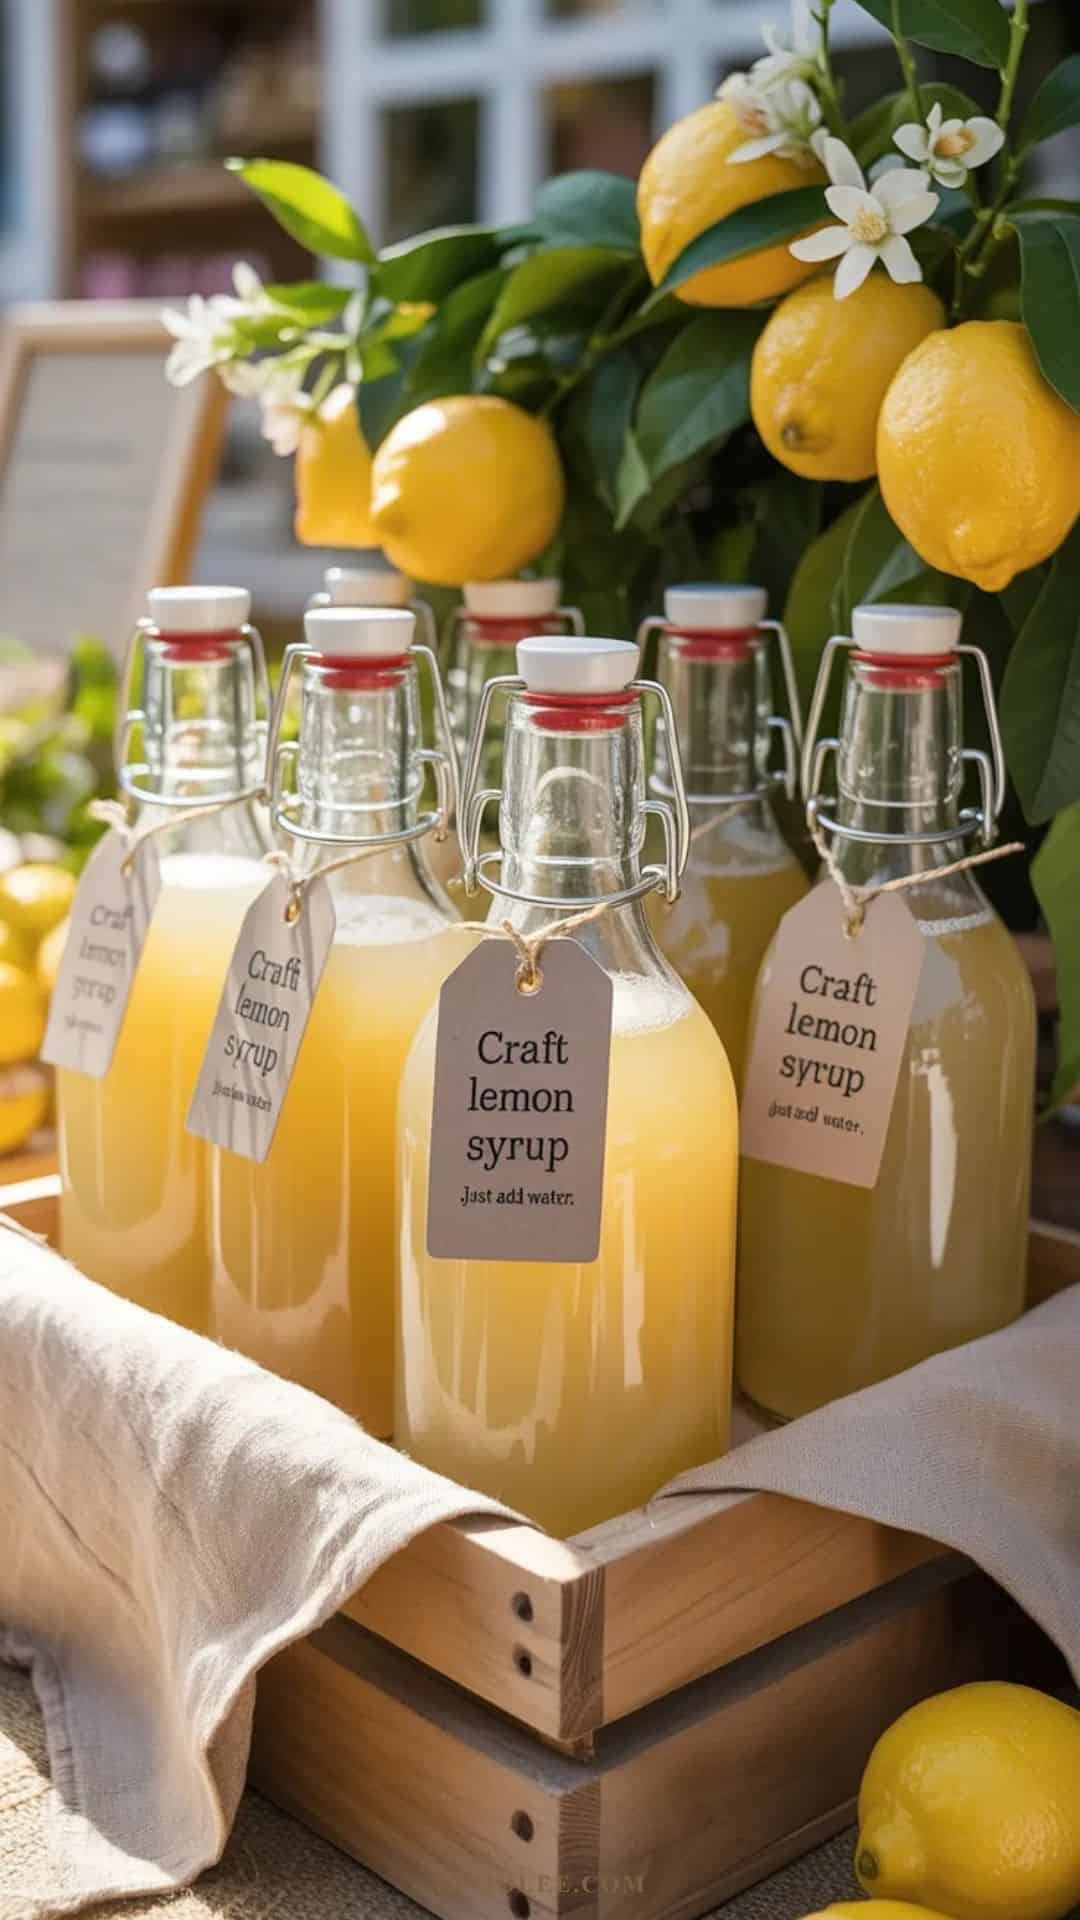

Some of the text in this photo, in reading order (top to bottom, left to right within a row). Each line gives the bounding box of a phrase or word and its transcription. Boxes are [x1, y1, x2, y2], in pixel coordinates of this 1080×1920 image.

[234, 980, 290, 1033] lemon
[799, 964, 877, 1007] Craft
[477, 1030, 569, 1065] Craft
[784, 1001, 877, 1051] lemon
[223, 1033, 278, 1078] syrup
[779, 1053, 865, 1098] syrup
[467, 1075, 574, 1113] lemon
[467, 1135, 569, 1173] syrup
[461, 1185, 492, 1207] Just
[527, 1189, 575, 1206] water.
